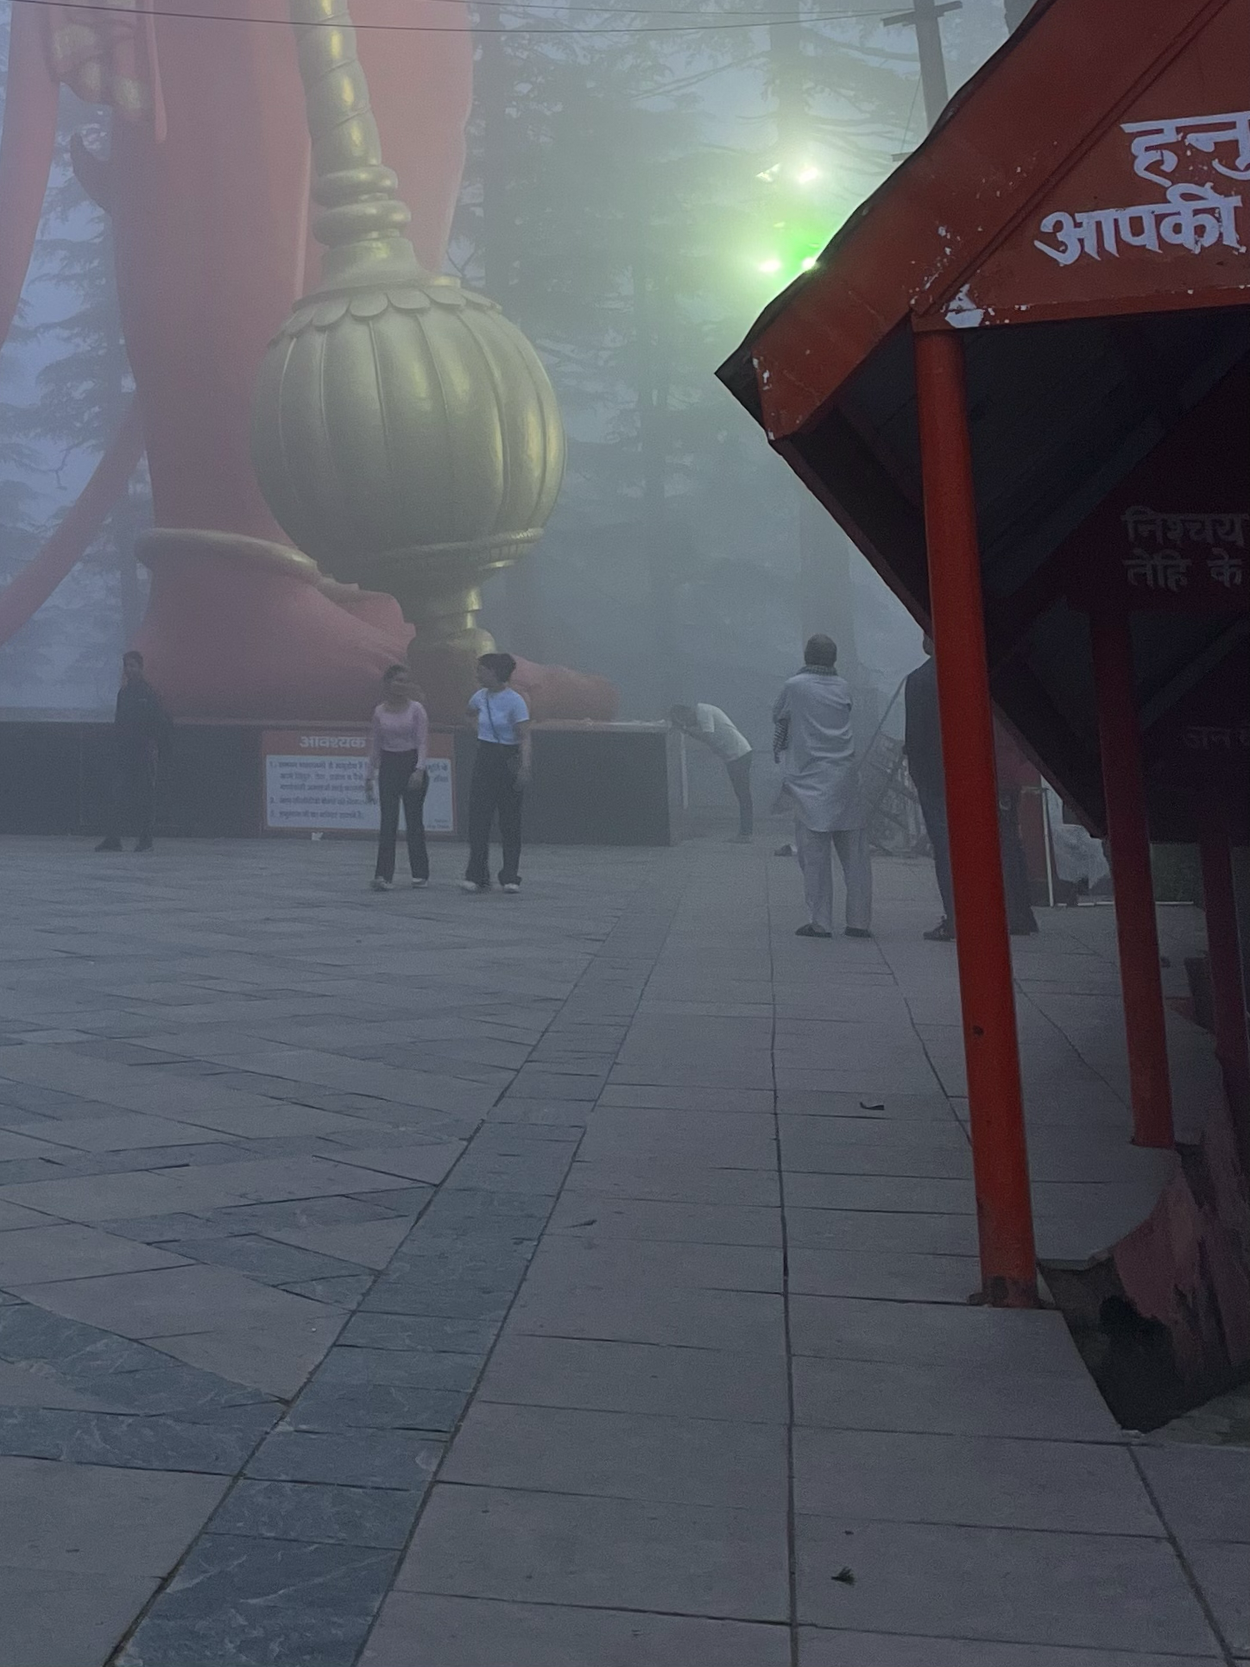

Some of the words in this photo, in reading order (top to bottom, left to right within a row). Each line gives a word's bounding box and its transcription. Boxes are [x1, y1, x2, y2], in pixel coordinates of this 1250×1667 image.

[1034, 182, 1243, 266] आपकी
[1120, 505, 1250, 548] निश्चय
[1206, 547, 1243, 588] के
[299, 735, 367, 749] आवश्यक
